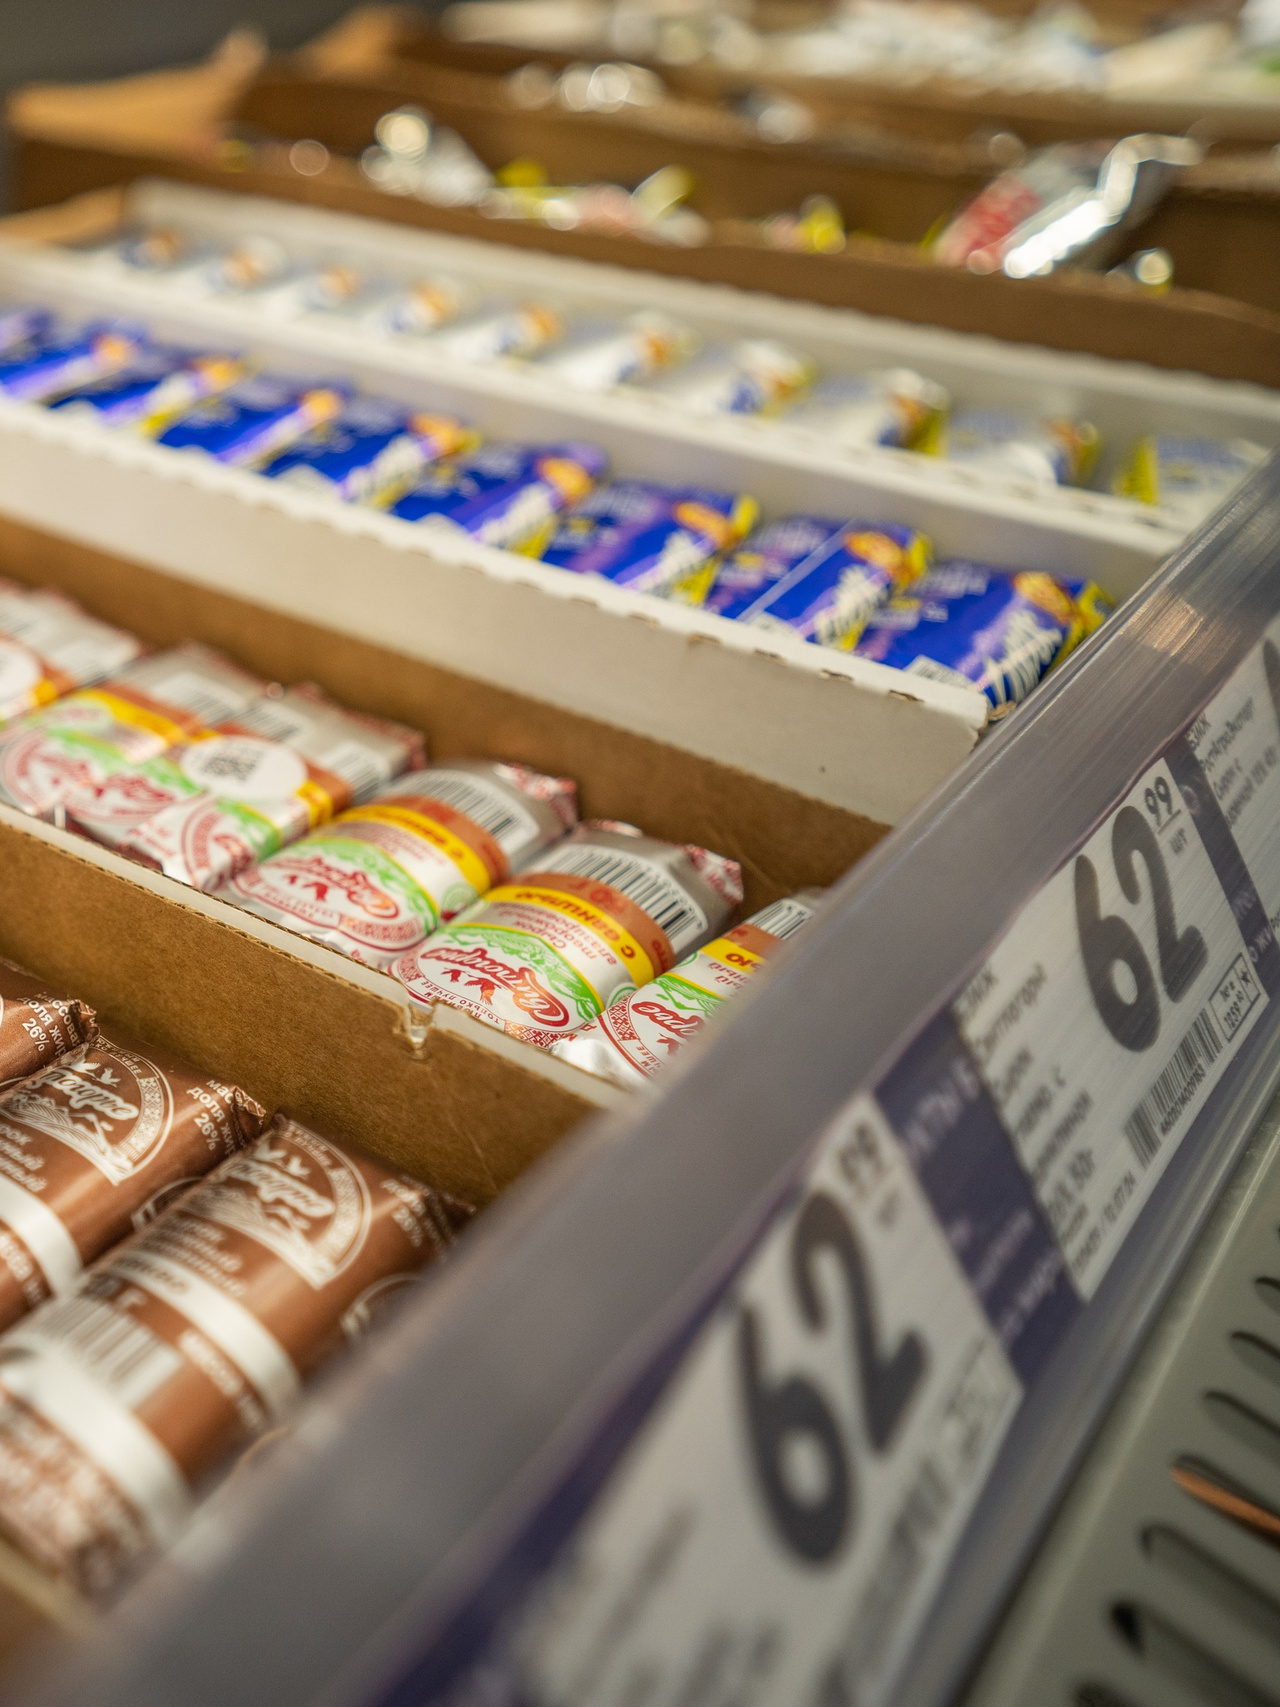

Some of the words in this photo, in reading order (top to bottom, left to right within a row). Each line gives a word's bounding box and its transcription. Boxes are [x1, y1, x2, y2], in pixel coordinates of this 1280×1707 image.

[1144, 776, 1173, 827] 99
[1074, 805, 1208, 1053] 62
[458, 997, 500, 1025] ТОЛЬКО
[20, 1016, 51, 1053] 26%
[185, 1085, 226, 1123] доля
[193, 1112, 222, 1152] 26%
[734, 1190, 930, 1576] 62
